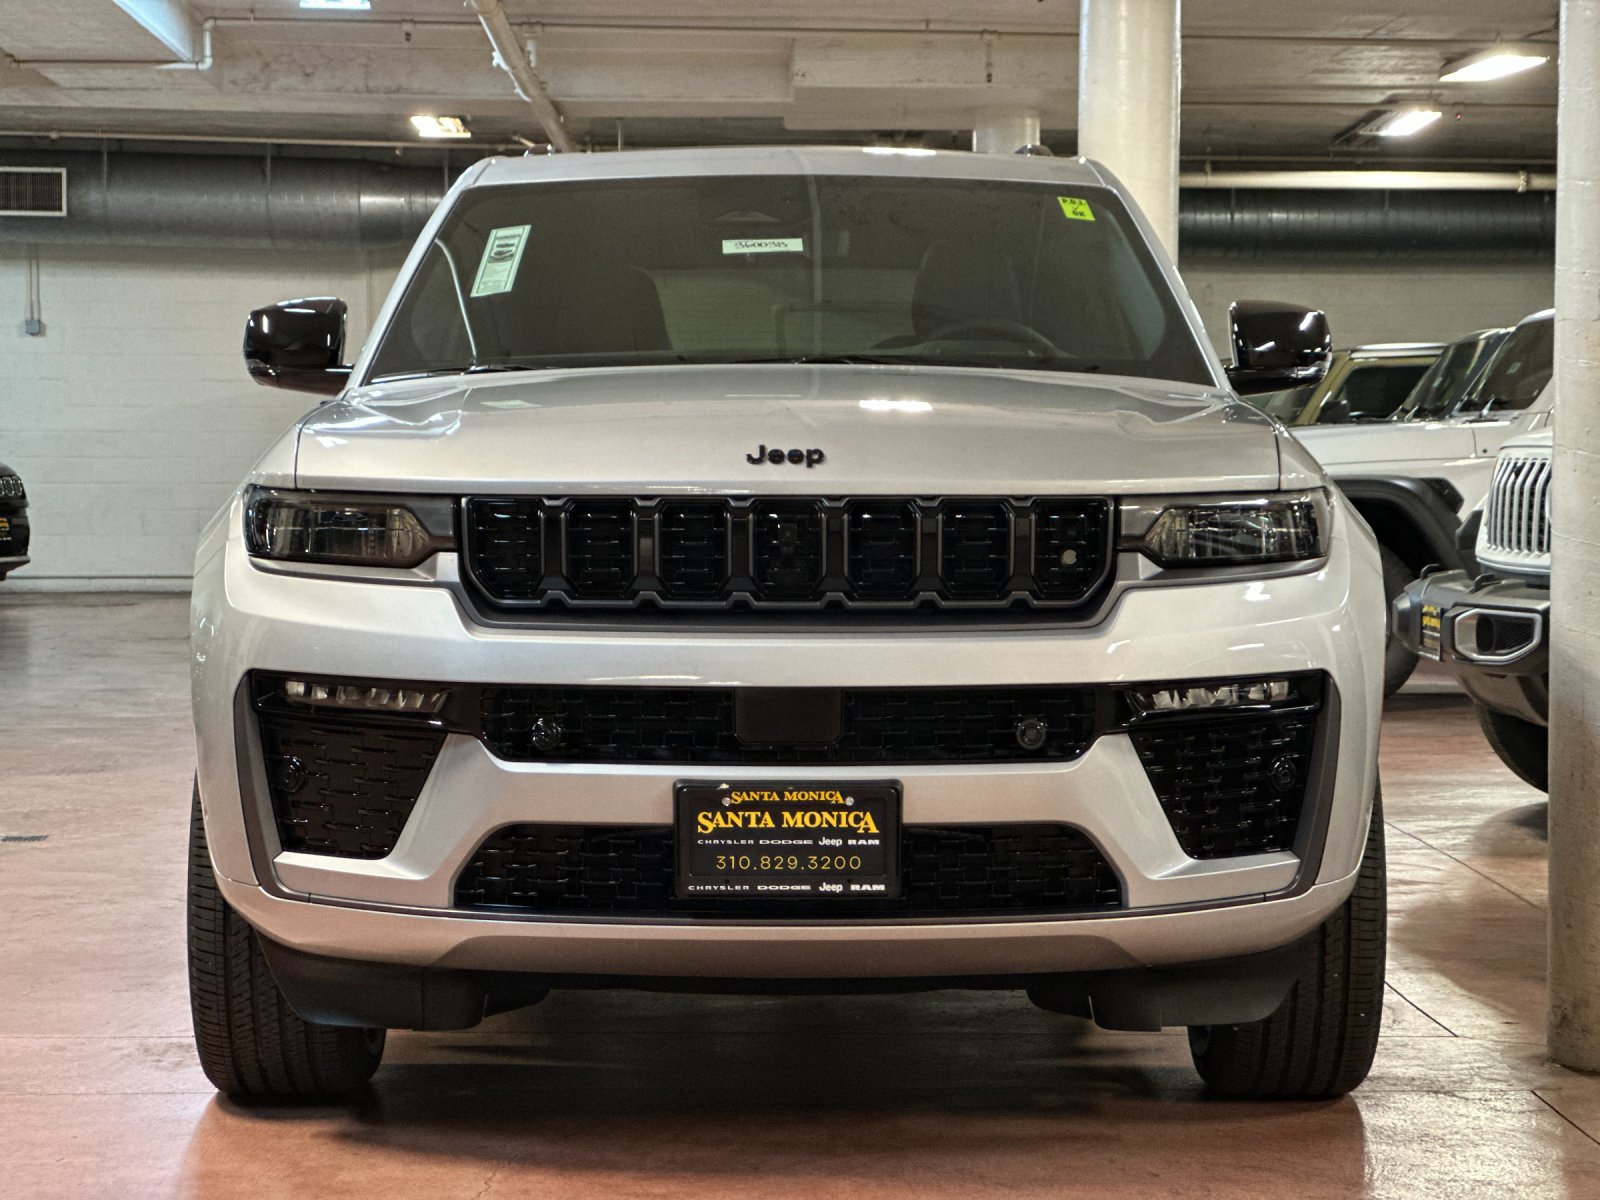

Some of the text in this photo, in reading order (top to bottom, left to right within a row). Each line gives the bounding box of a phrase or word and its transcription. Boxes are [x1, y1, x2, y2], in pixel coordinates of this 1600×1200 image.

[746, 444, 825, 468] Jeep
[731, 790, 845, 805] SANTA MONICA
[697, 811, 880, 834] SANTA MONICA
[818, 836, 843, 847] Jeep
[716, 856, 861, 870] 310.829.3200
[818, 882, 844, 893] Jeep
